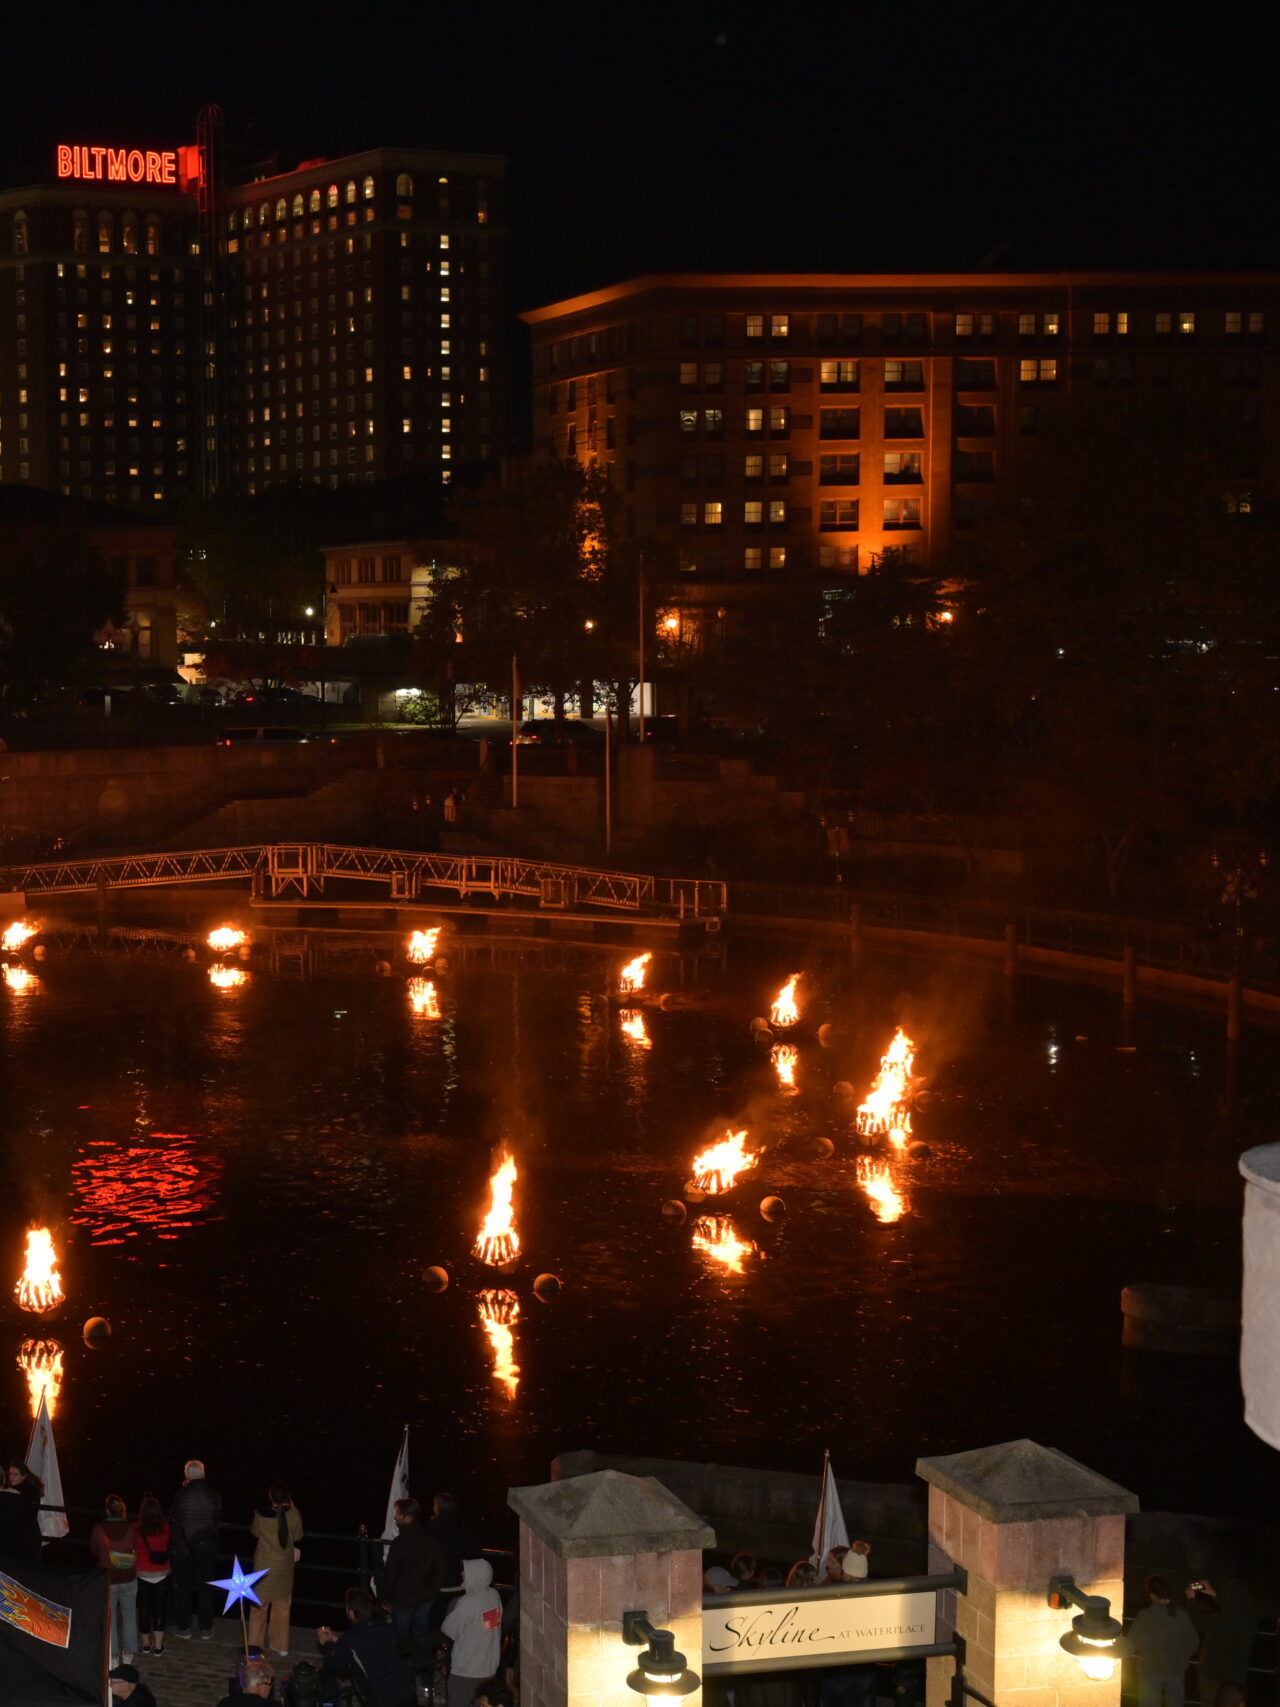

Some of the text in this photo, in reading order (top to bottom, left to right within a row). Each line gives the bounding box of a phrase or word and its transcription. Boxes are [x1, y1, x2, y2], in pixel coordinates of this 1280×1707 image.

[57, 144, 176, 184] BILTMORE
[709, 1606, 925, 1656] Skyline AT WATERPLACE
